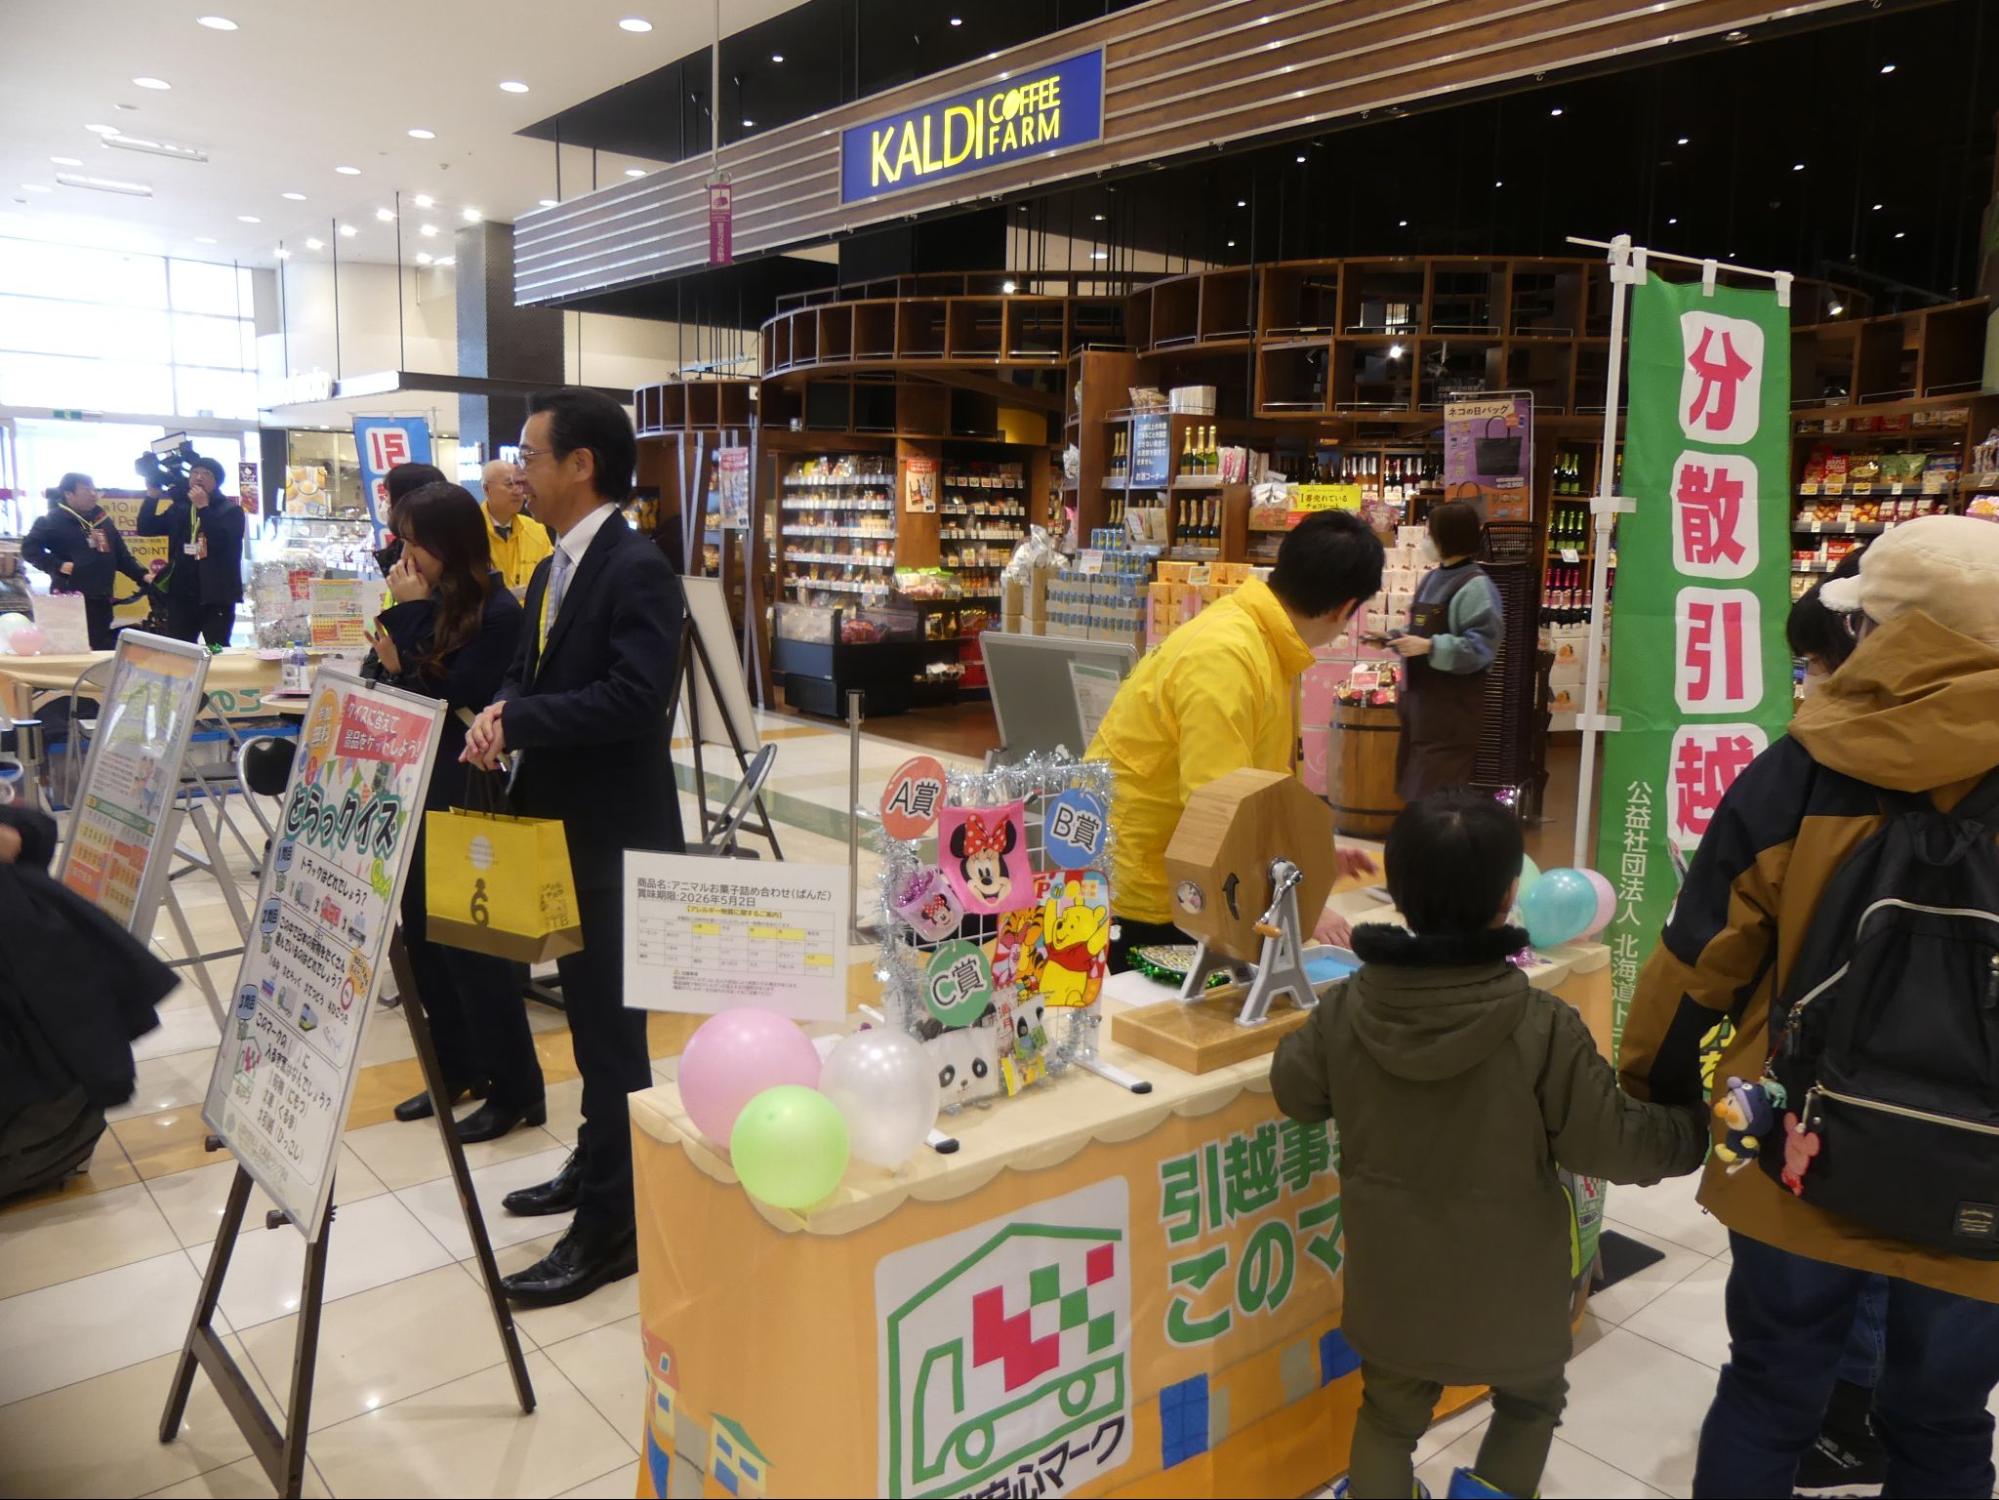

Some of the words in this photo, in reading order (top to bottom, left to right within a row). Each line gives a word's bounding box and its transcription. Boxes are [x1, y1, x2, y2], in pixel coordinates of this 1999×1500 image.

[988, 75, 1061, 124] COFFEE
[872, 98, 984, 187] KALDI
[988, 108, 1060, 156] FARM
[1448, 404, 1510, 417] ネコの日バッグ
[1675, 325, 1754, 837] 分散引越
[285, 787, 403, 857] とらっクイズ
[889, 780, 939, 817] A賞
[1053, 806, 1101, 852] B賞
[1616, 780, 1653, 927] 公益社団法人
[637, 889, 757, 908] 賞味期限:2026年5月2日
[932, 955, 985, 1007] C賞
[1611, 934, 1640, 1038] 北海道ト
[1160, 1117, 1341, 1247] 引越事
[957, 1414, 1126, 1499] 安心マーク
